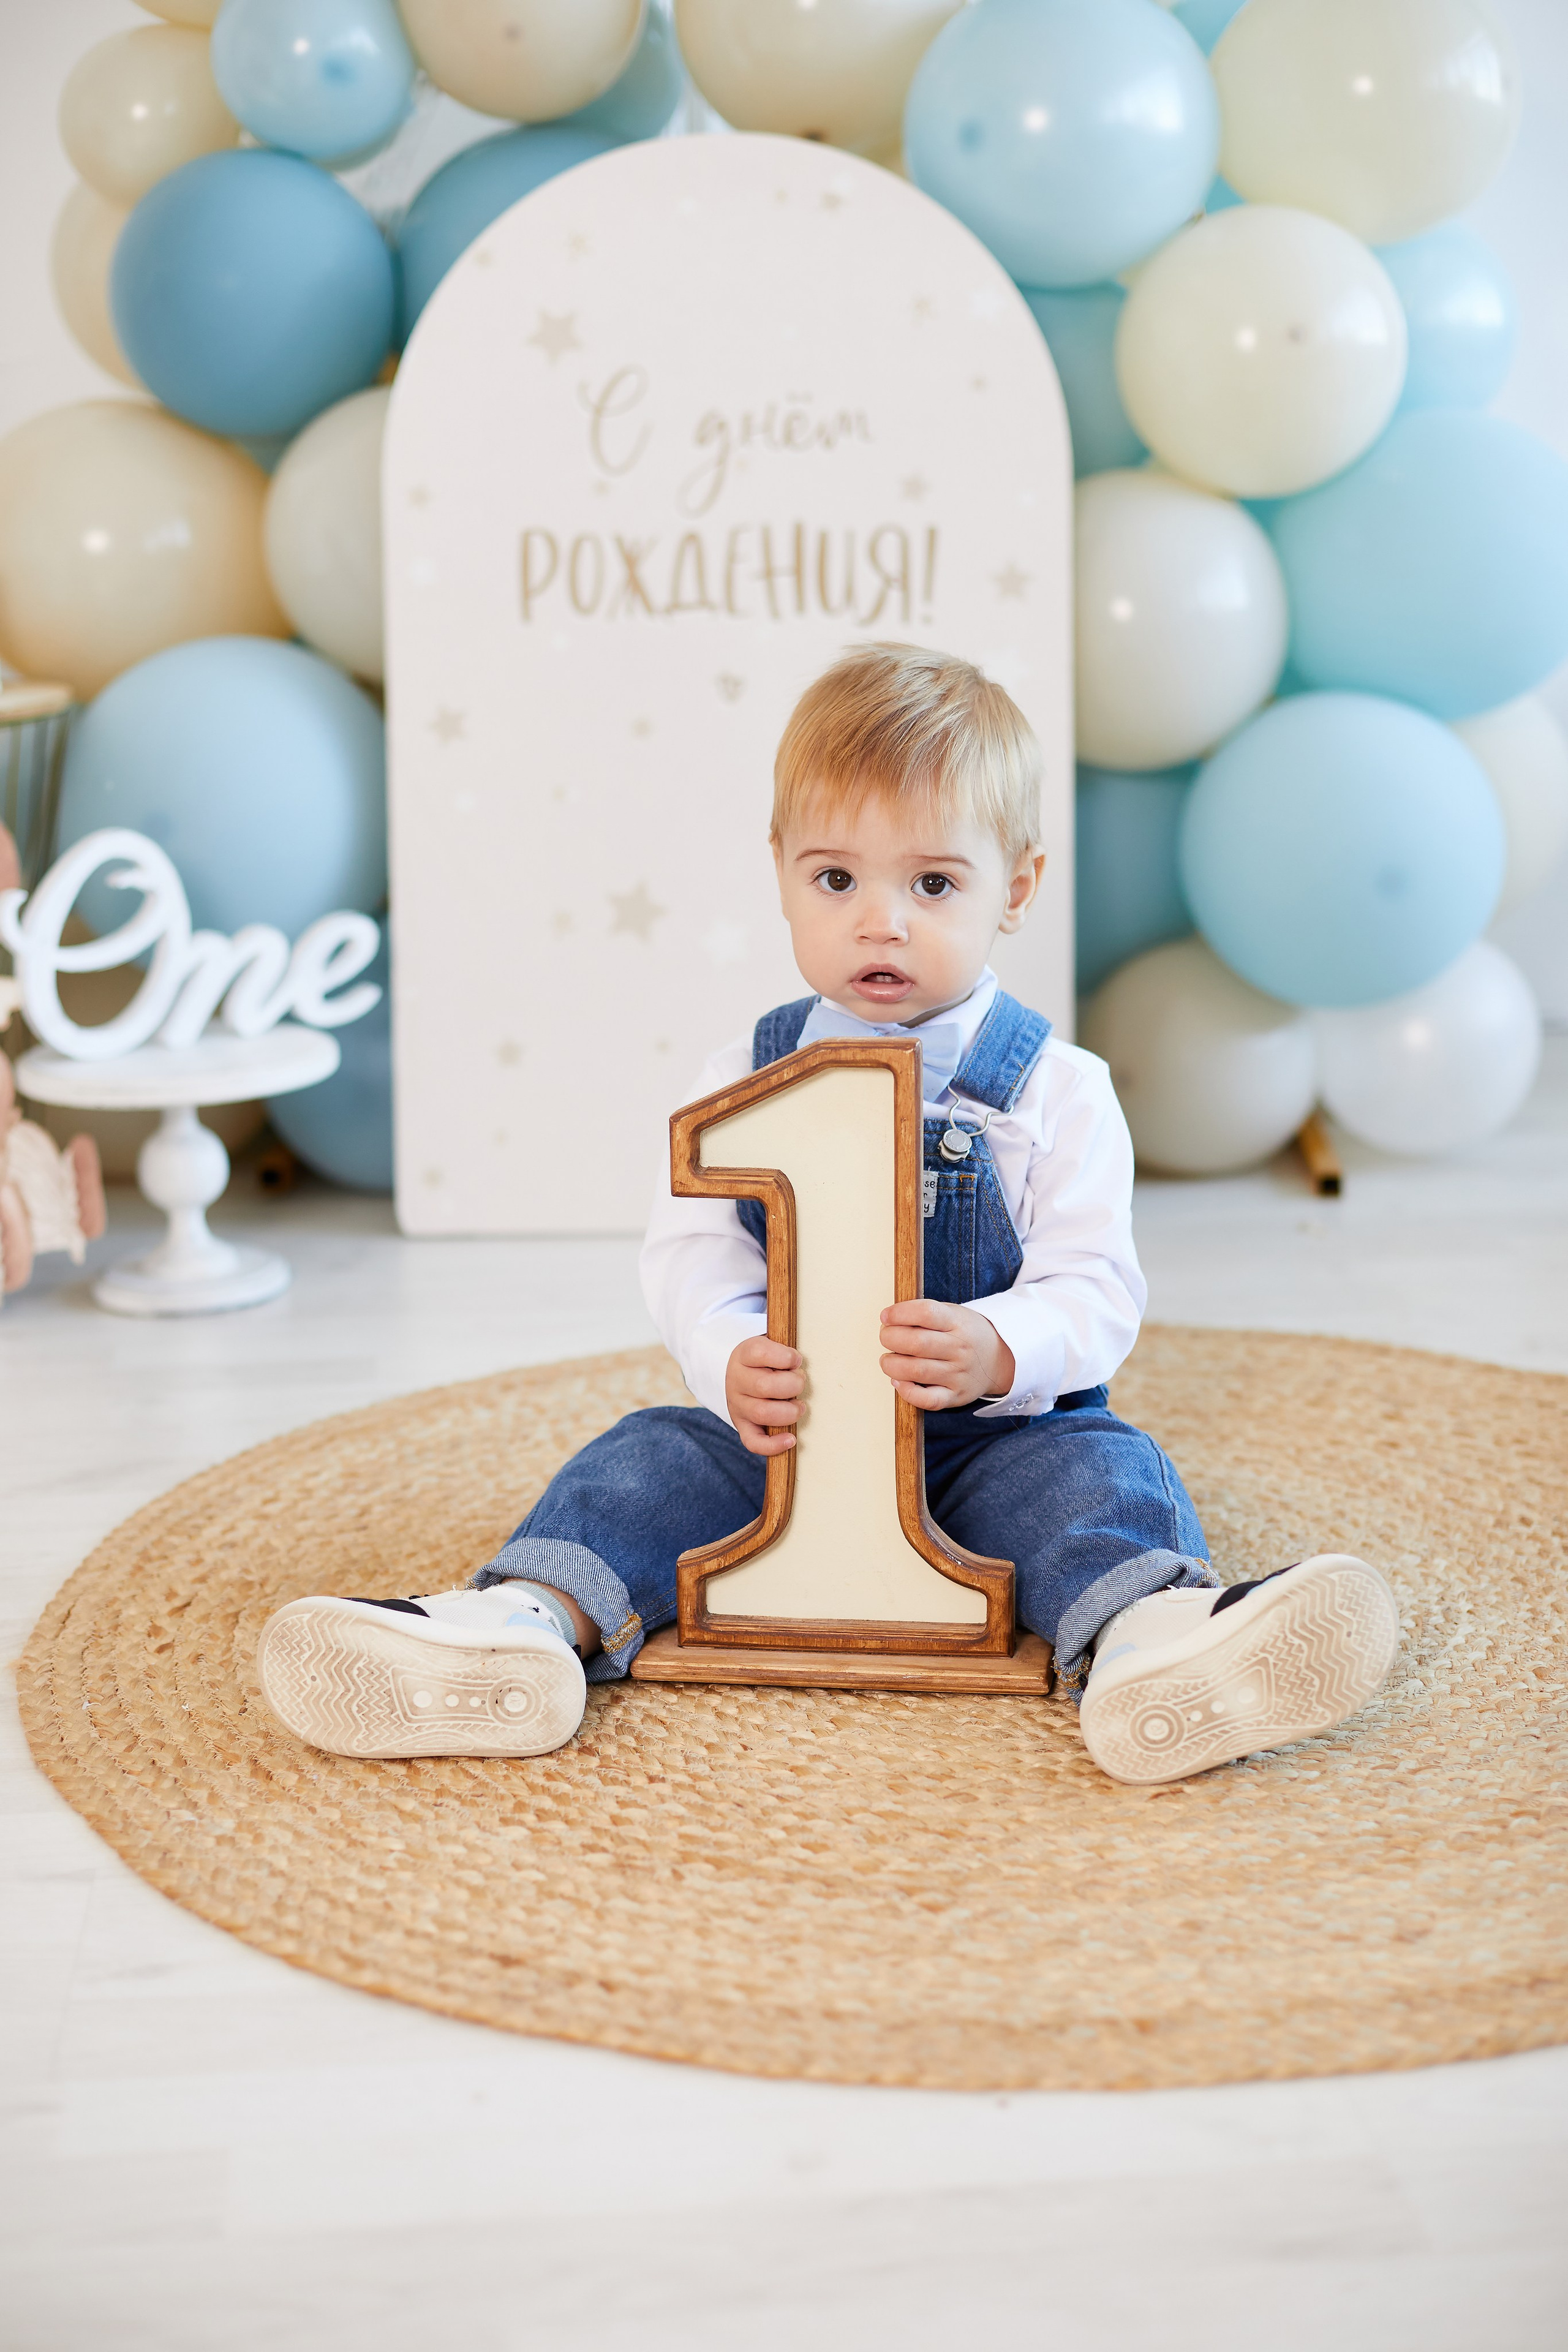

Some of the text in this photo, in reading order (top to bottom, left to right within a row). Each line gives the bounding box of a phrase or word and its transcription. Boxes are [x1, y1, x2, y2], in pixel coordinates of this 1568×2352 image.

[517, 519, 940, 628] РОЖДЕНИЯ!
[0, 827, 383, 1061] One
[924, 1180, 935, 1189] se
[669, 1036, 1016, 1658] 1
